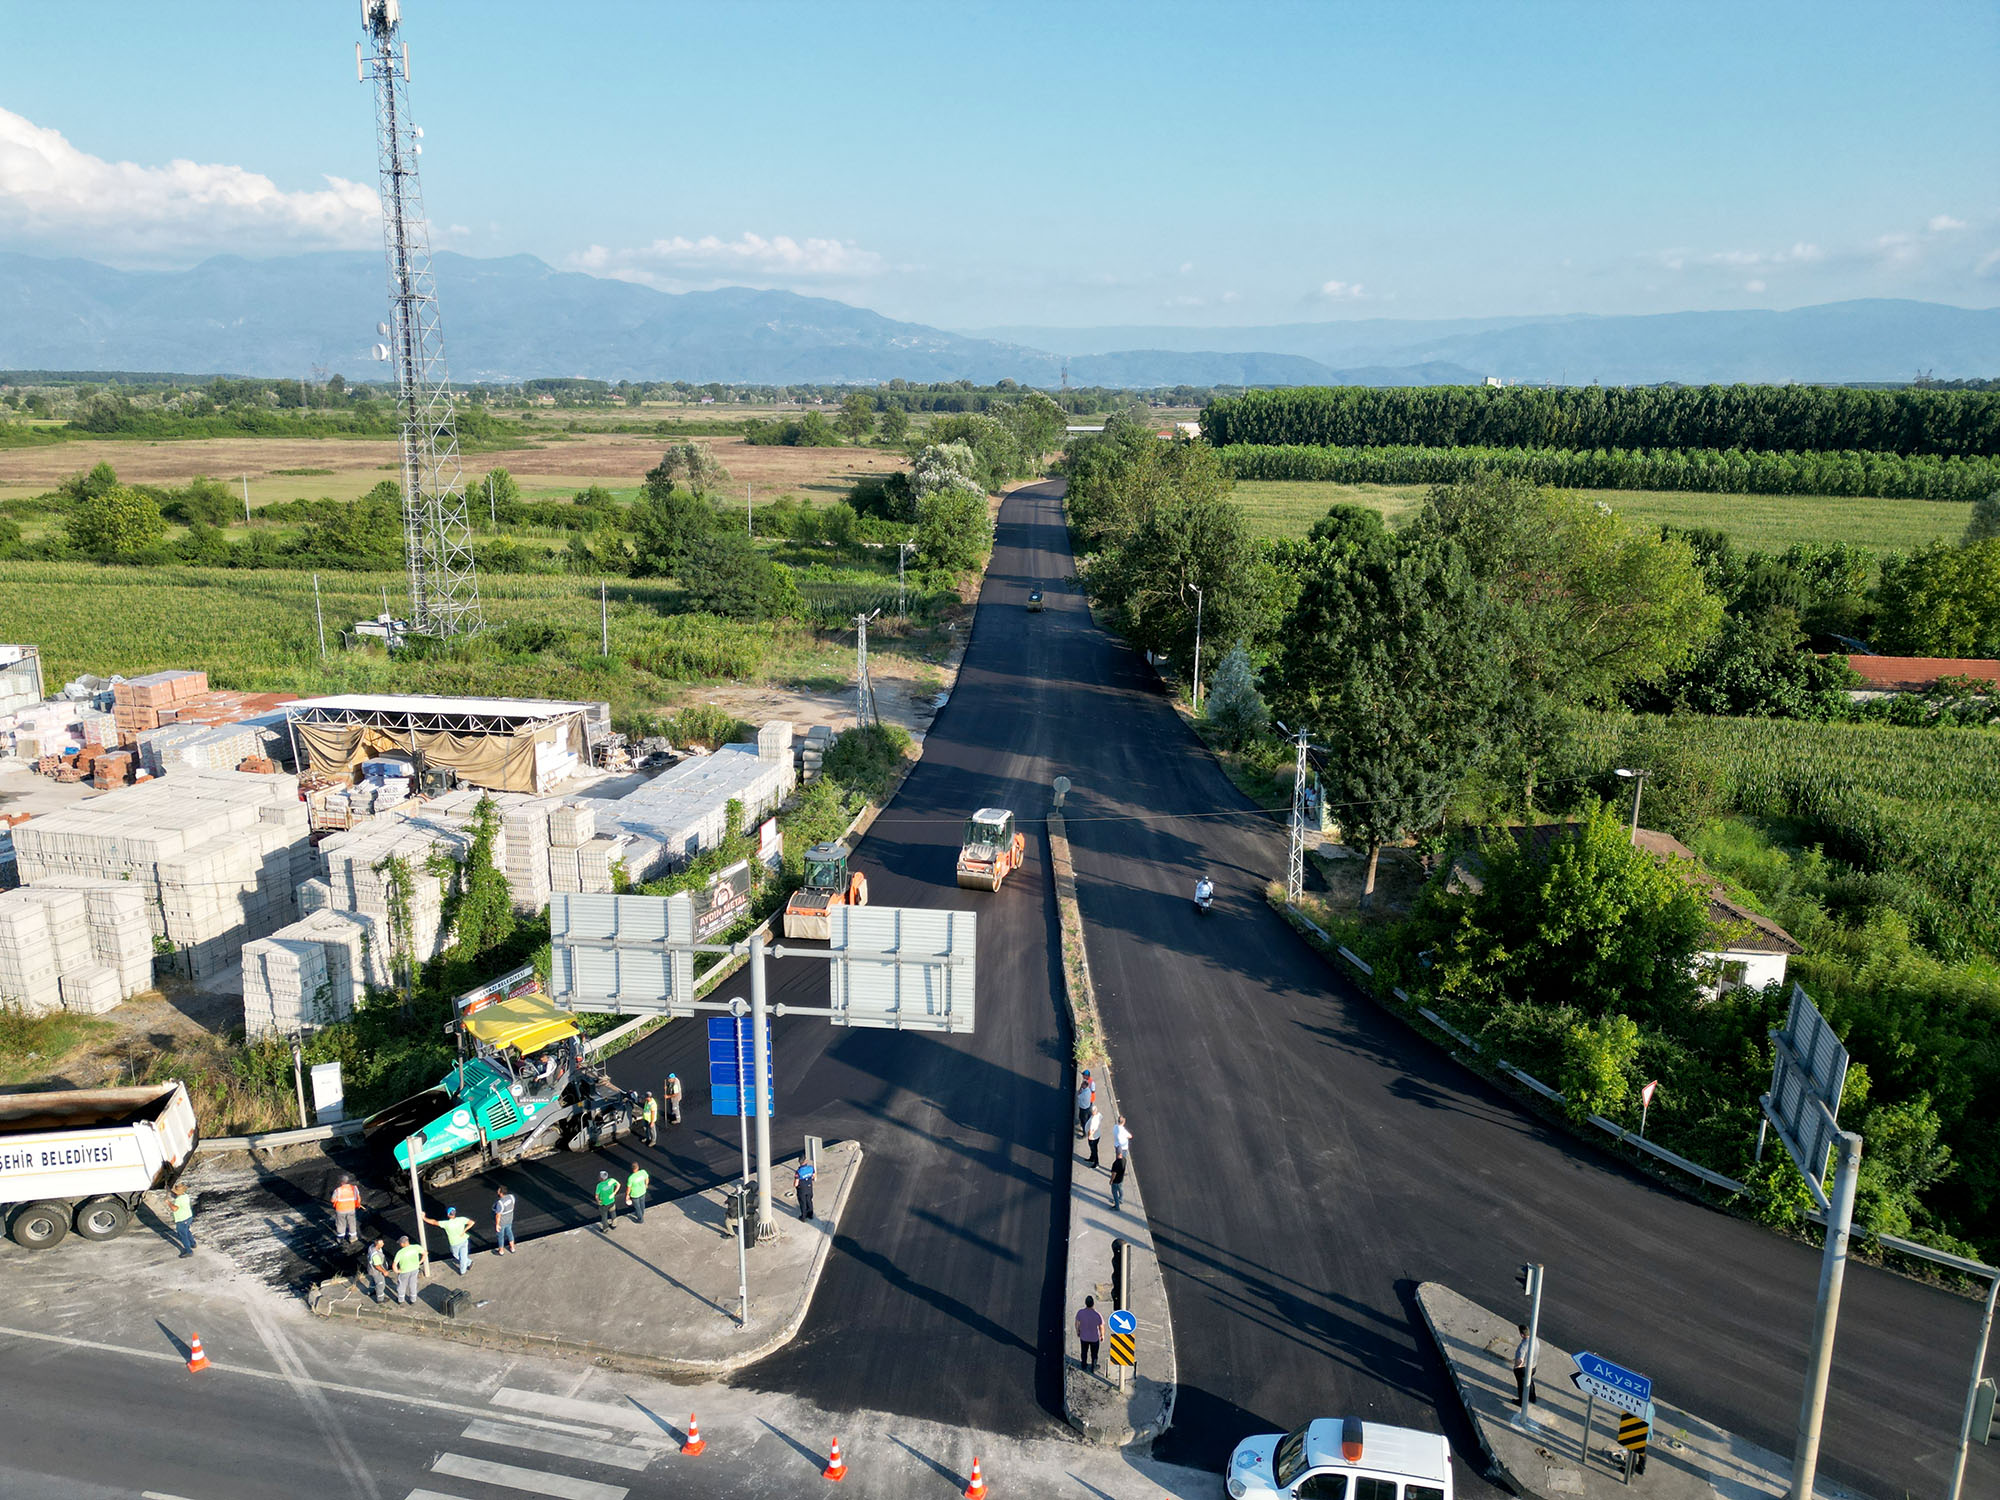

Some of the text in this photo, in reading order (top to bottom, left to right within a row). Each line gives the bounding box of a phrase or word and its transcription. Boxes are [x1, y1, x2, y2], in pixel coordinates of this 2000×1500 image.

[723, 894, 747, 914] METAL
[41, 1142, 113, 1166] BELEDİYESİ
[1585, 1377, 1642, 1407] Askerlik
[1593, 1363, 1646, 1394] Akyazı
